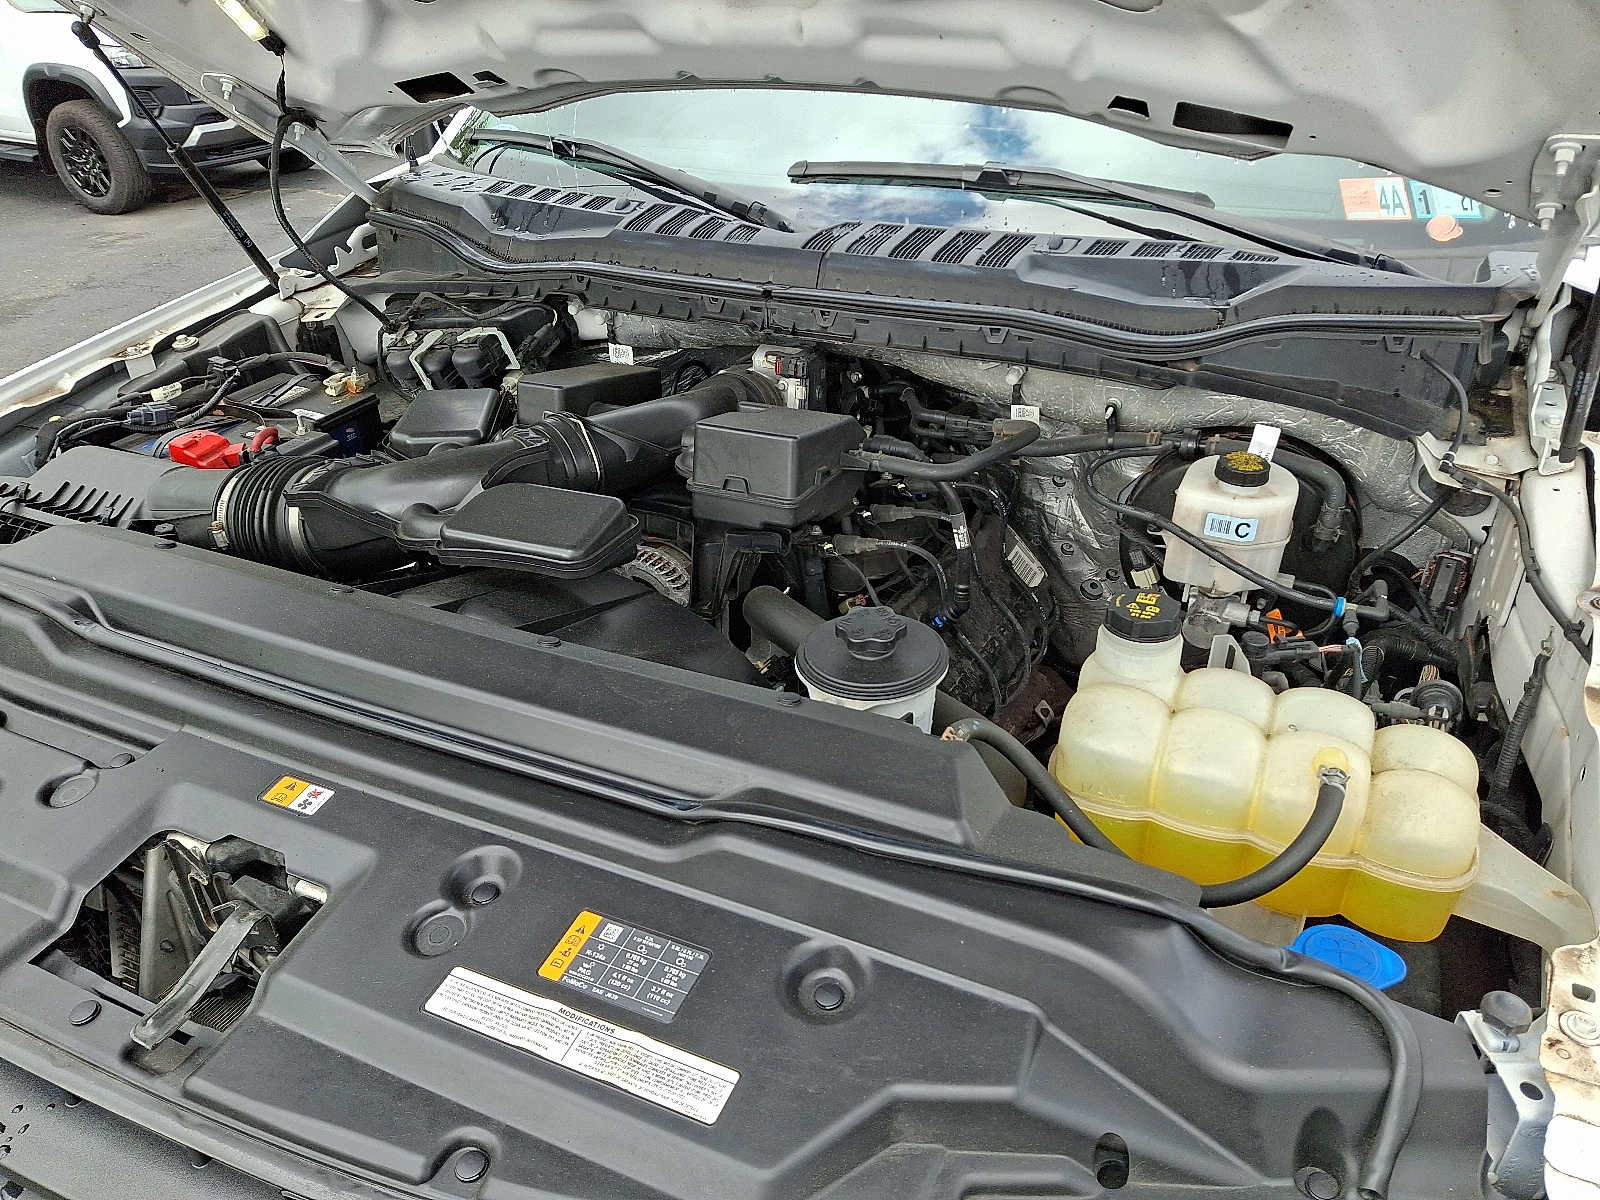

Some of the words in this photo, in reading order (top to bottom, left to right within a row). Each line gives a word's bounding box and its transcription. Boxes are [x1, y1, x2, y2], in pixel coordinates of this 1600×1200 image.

[1380, 184, 1407, 217] 4A
[1234, 522, 1251, 539] C
[576, 966, 592, 976] PAG
[558, 1007, 616, 1035] MODIFICATIONS
